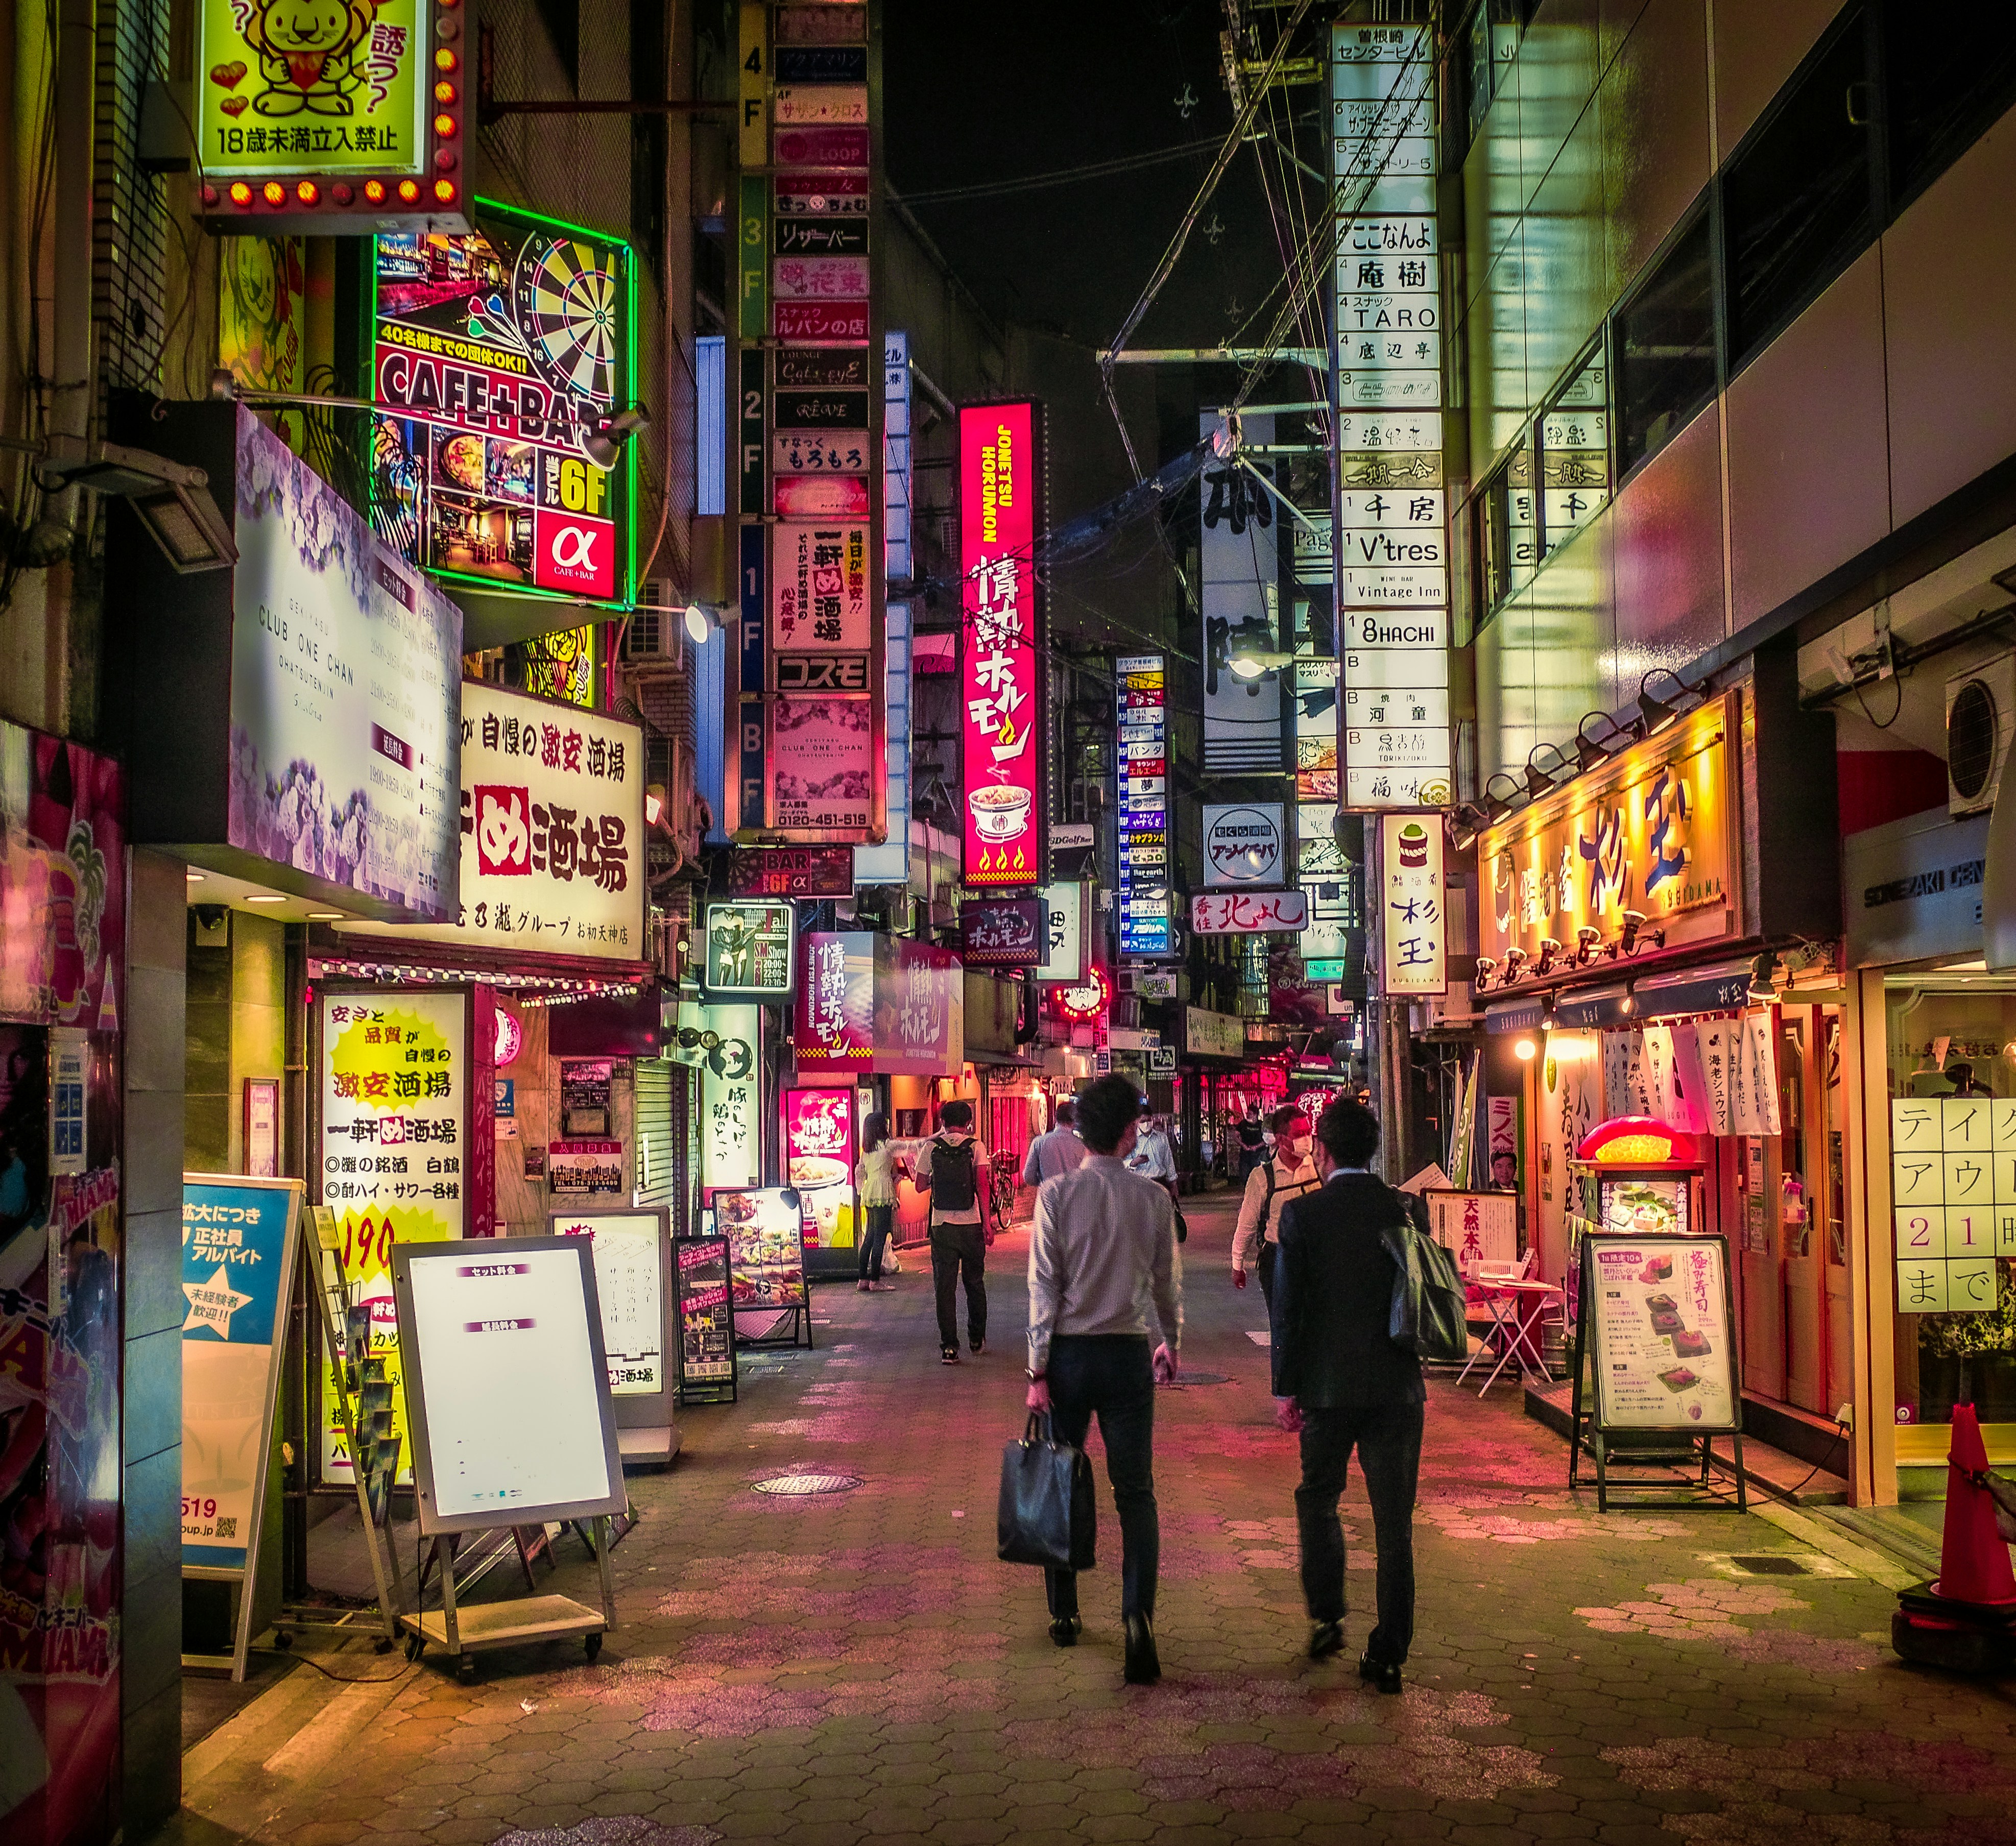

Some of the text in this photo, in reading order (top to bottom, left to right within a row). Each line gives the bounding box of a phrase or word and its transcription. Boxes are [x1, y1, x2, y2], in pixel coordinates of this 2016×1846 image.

[1358, 29, 1404, 44] 曽根崎
[1338, 45, 1426, 60] センタービル
[1335, 104, 1343, 114] 6
[218, 126, 398, 153] 18歳未満立入禁止
[1353, 222, 1431, 250] ここなんよ
[1340, 259, 1347, 269] 4
[1340, 297, 1393, 307] 4 スナック
[779, 308, 821, 318] スナック
[1354, 309, 1435, 327] TARO
[1341, 335, 1430, 359] 4 底辺亭
[1342, 373, 1351, 384] 3
[1344, 418, 1351, 430] 2
[779, 438, 823, 448] すなっく
[789, 450, 862, 468] もろもろ
[997, 424, 1013, 507] JONETSU
[560, 457, 607, 514] 6F
[981, 445, 997, 543] HORUMON
[1347, 494, 1435, 521] 1 千房
[1346, 533, 1438, 562] 1 V'tres
[554, 565, 595, 582] CAFE+BAR
[1349, 572, 1353, 582] 1
[813, 530, 844, 642] 一軒め酒場
[1358, 586, 1440, 598] Vintage Inn
[1349, 616, 1355, 627] 1
[258, 604, 354, 688] CLUB ONE CHAN
[1348, 657, 1358, 667] B
[279, 659, 334, 700] OHATSUTENJIN
[781, 659, 864, 688] コスモ
[1348, 692, 1358, 703] B
[1350, 732, 1361, 744] B
[779, 814, 866, 825] 0120-451-519
[1130, 834, 1164, 843] カサブランカ
[767, 854, 809, 871] BAR
[770, 874, 790, 892] 6F
[577, 921, 629, 945] お初天神店
[1390, 897, 1439, 968] 杉玉
[769, 945, 787, 959] Show
[330, 1005, 385, 1024] 安さと
[365, 1026, 420, 1045] 品質が
[405, 1048, 452, 1063] 自慢の
[334, 1071, 452, 1099] 激安酒場
[1708, 1054, 1726, 1130] 海老シュウマイ
[327, 1116, 457, 1145] 一軒め酒場
[1492, 1100, 1515, 1147] ミノベ
[426, 1156, 460, 1175] 白鶴
[193, 1227, 243, 1247] 正社員
[192, 1246, 261, 1265] アルバイト
[472, 1266, 517, 1276] セット料金
[1690, 1250, 1709, 1313] 極み寿司
[1906, 1269, 1990, 1305] まで
[190, 1289, 239, 1308] 未経験者
[193, 1303, 229, 1325] 歓迎!!
